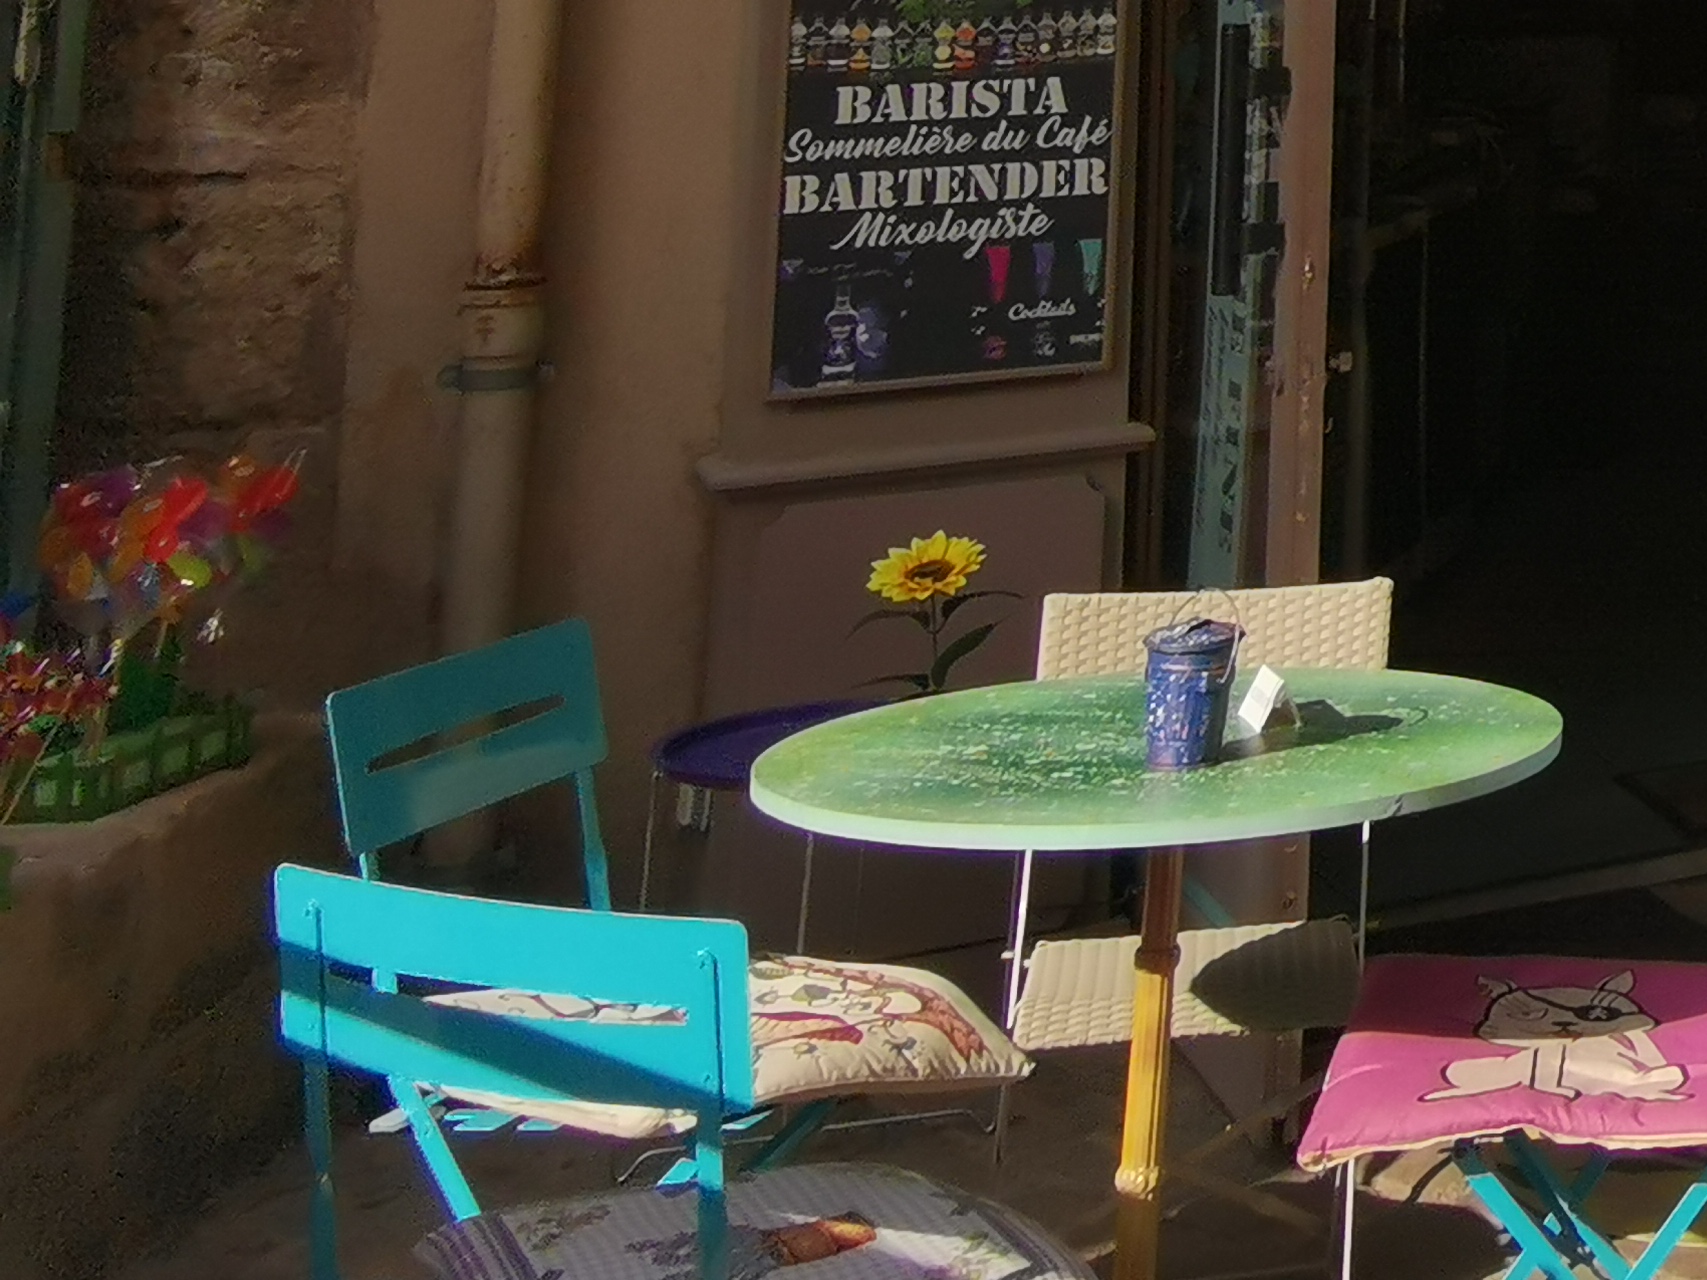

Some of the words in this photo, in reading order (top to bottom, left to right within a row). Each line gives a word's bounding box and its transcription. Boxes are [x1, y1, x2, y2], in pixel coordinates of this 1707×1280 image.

[834, 77, 1070, 125] BARISTA
[784, 123, 977, 164] Sommelière
[976, 121, 1031, 151] du
[1036, 115, 1116, 151] Café
[782, 157, 1110, 216] BARTENDER
[829, 203, 1055, 260] Mixologiste
